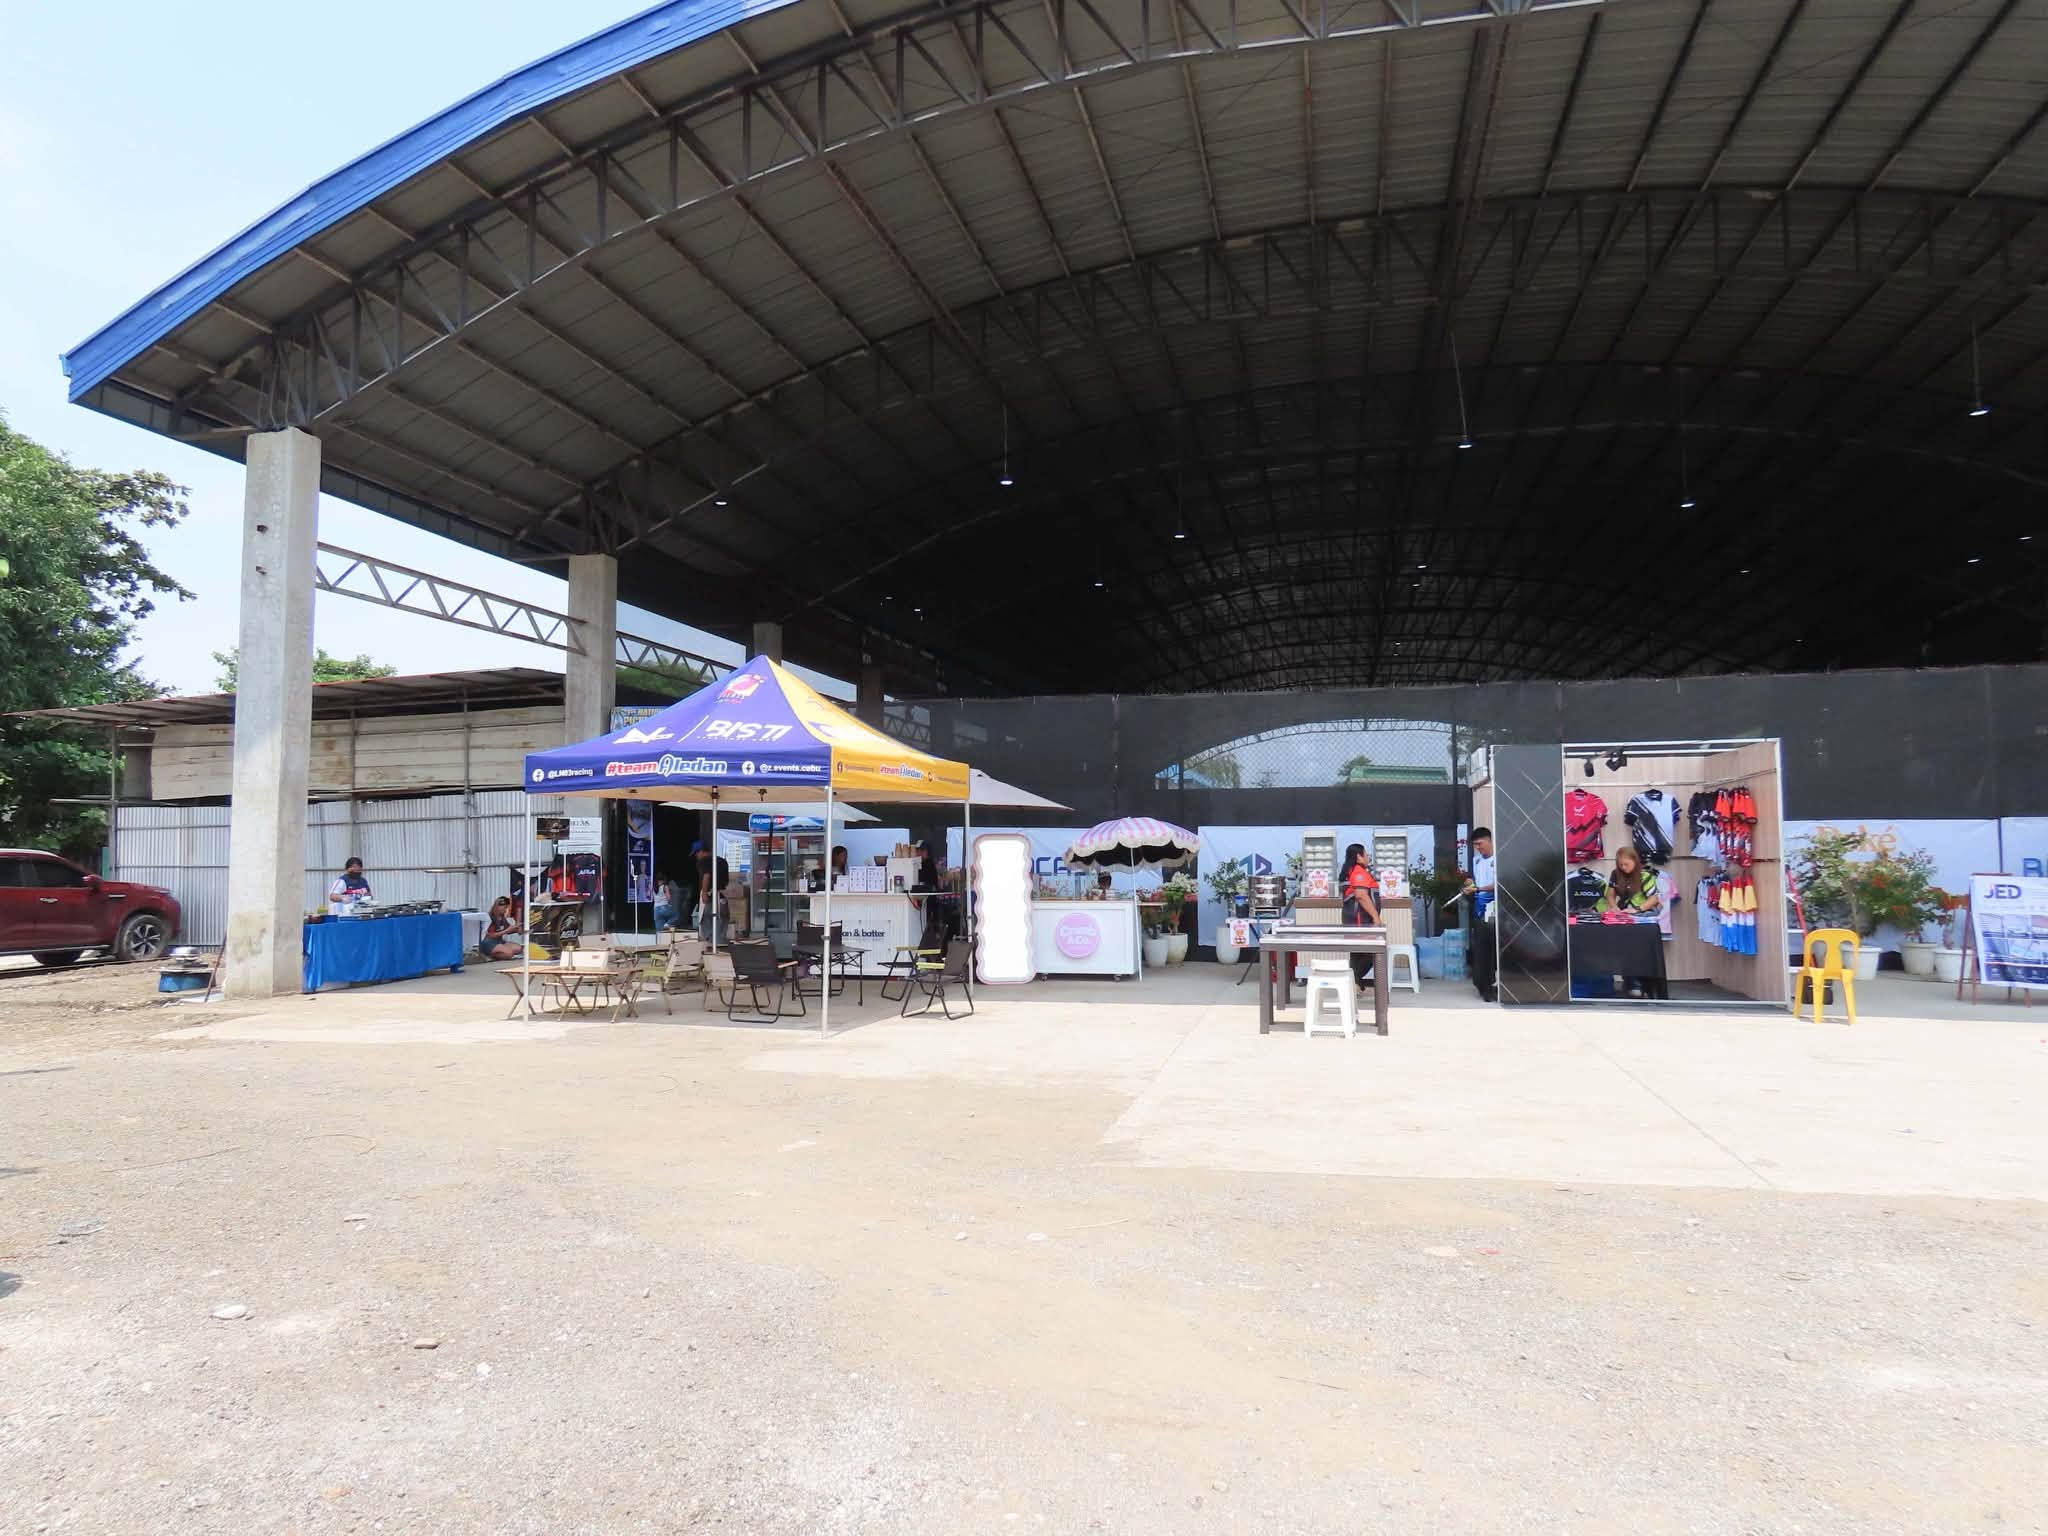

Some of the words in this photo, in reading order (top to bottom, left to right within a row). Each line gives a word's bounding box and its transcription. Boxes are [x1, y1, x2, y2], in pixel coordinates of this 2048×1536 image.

[1984, 884, 2022, 899] JED
[853, 927, 860, 937] &
[861, 928, 886, 937] batter
